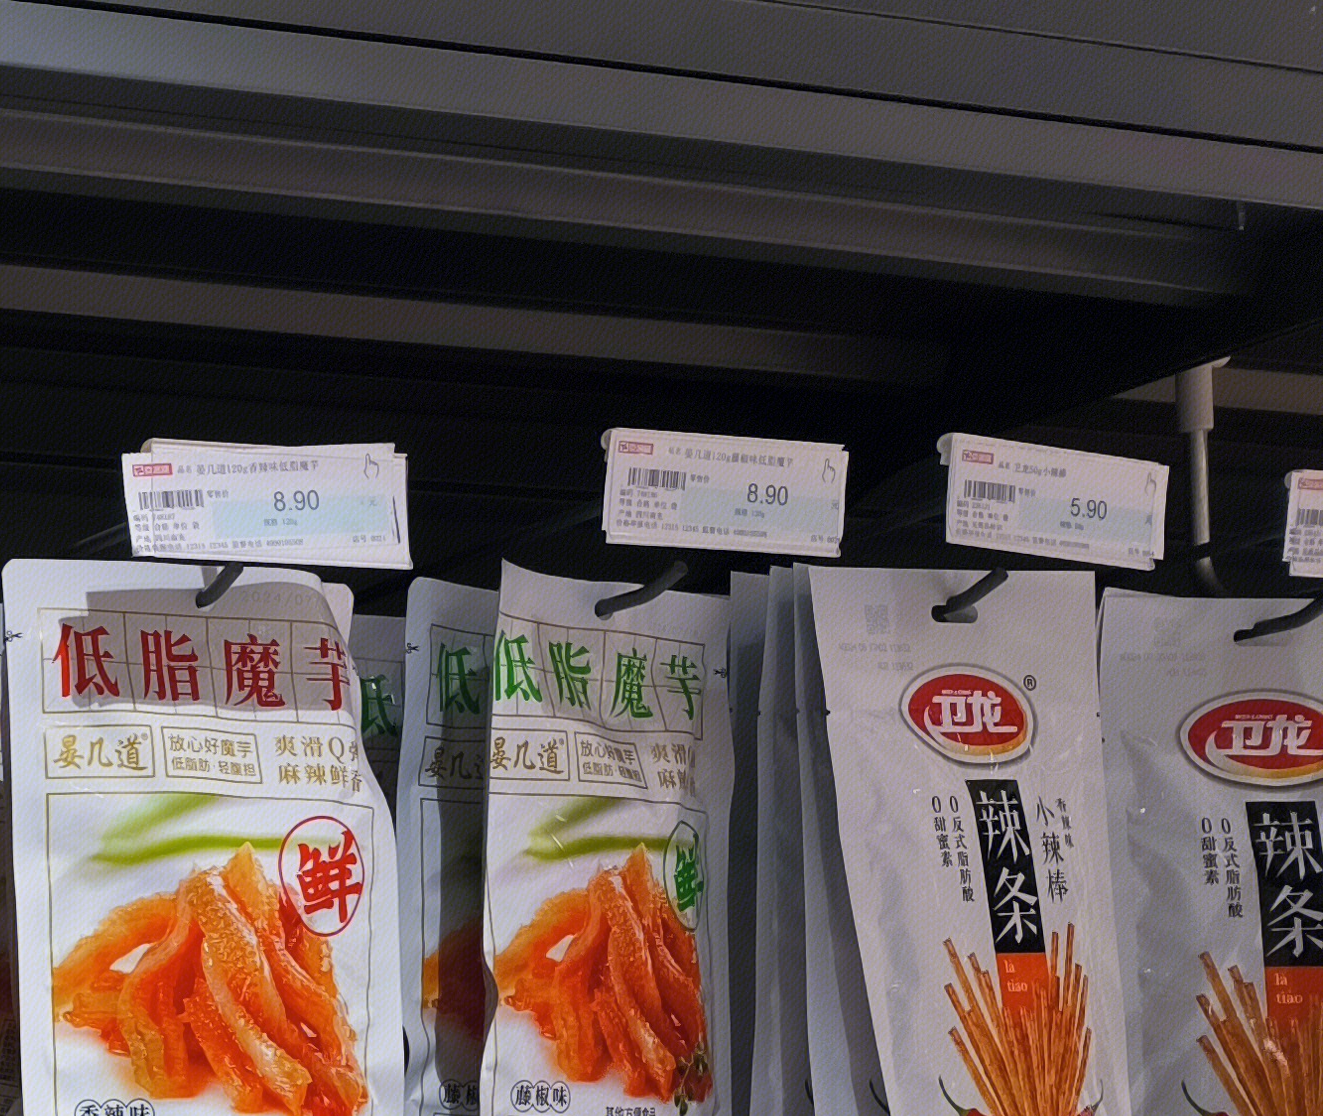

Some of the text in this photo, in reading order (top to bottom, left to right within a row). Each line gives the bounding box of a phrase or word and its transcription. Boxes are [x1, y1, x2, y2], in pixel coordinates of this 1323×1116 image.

[273, 490, 319, 511] 8.90
[746, 482, 788, 506] 8.90
[1070, 498, 1108, 520] 5.90
[52, 621, 352, 712] 低脂魔芋
[493, 629, 703, 720] 低脂魔芋
[925, 690, 1018, 734] 卫龙
[54, 736, 149, 772] 晏几道
[293, 830, 363, 923] 鲜
[976, 790, 1039, 943] 辣条
[1035, 800, 1069, 901] 小辣棒
